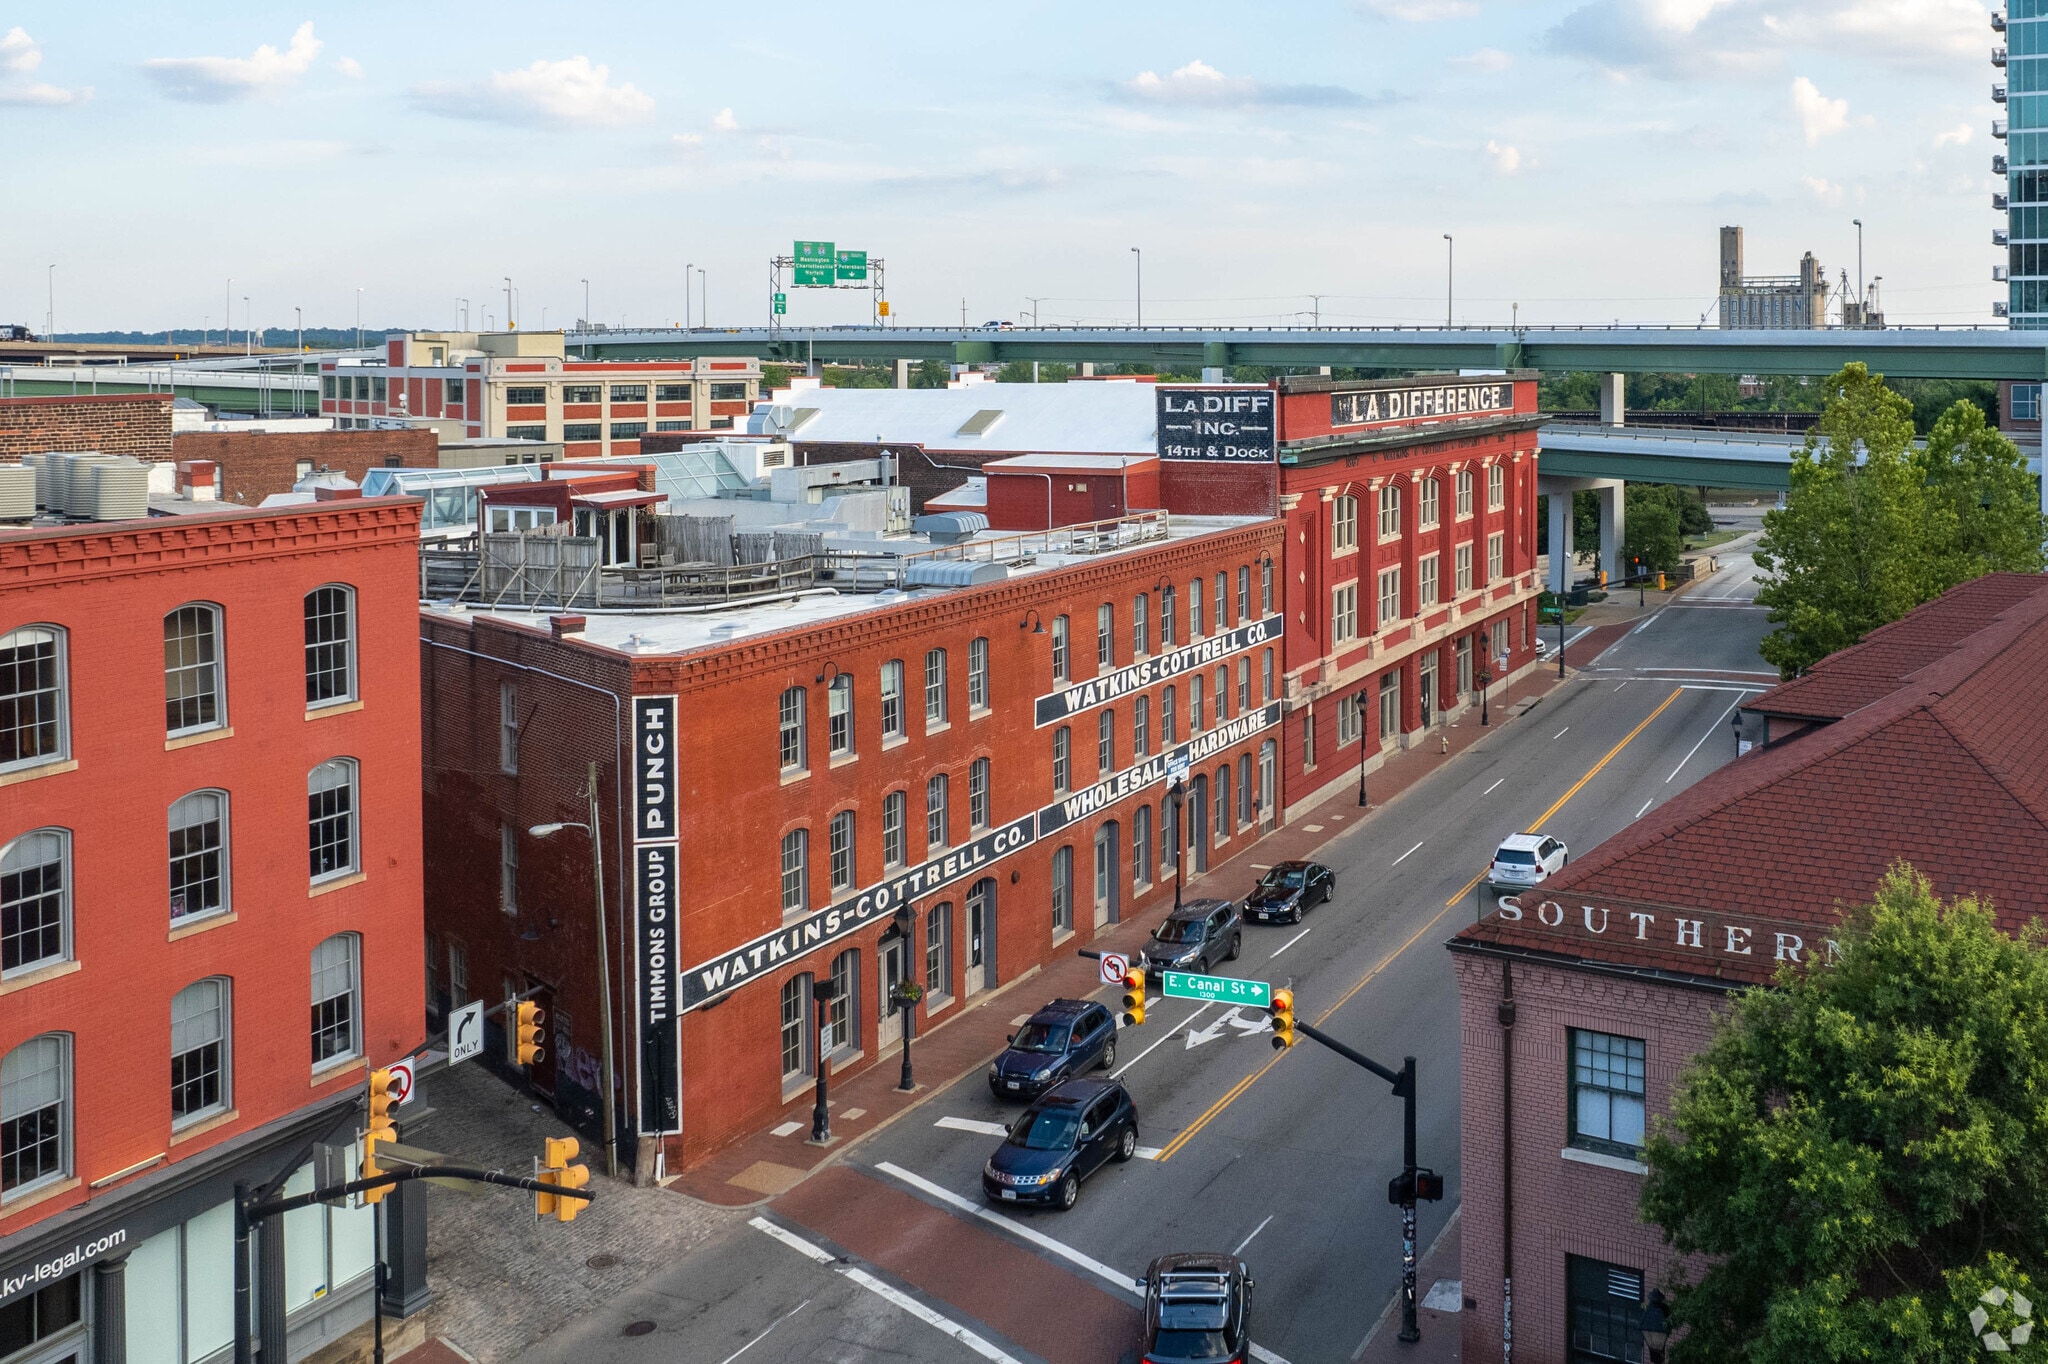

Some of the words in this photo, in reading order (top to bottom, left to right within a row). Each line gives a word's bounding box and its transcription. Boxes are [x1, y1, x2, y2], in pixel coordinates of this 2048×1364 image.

[1721, 300, 1802, 312] SOUTHERN
[1203, 396, 1270, 413] DIFF
[1352, 394, 1380, 423] LA
[1194, 420, 1240, 436] INC.
[1206, 445, 1219, 457] &
[1065, 632, 1241, 713] WATKINS-COTTRELL
[1247, 622, 1268, 645] CO.
[1188, 709, 1267, 762] HARDWARE
[646, 708, 665, 829] PUNCH
[648, 851, 666, 923] GROUP
[702, 846, 985, 992] WATKINS-COTTRELL
[993, 826, 1026, 854] CO.
[1498, 895, 1851, 968] SOUTHERN
[650, 928, 667, 1024] TIMMONS
[1168, 975, 1182, 988] E.
[1187, 976, 1225, 993] Canal
[1231, 982, 1246, 995] St
[1199, 991, 1216, 999] 1300
[454, 1039, 479, 1059] ONLY
